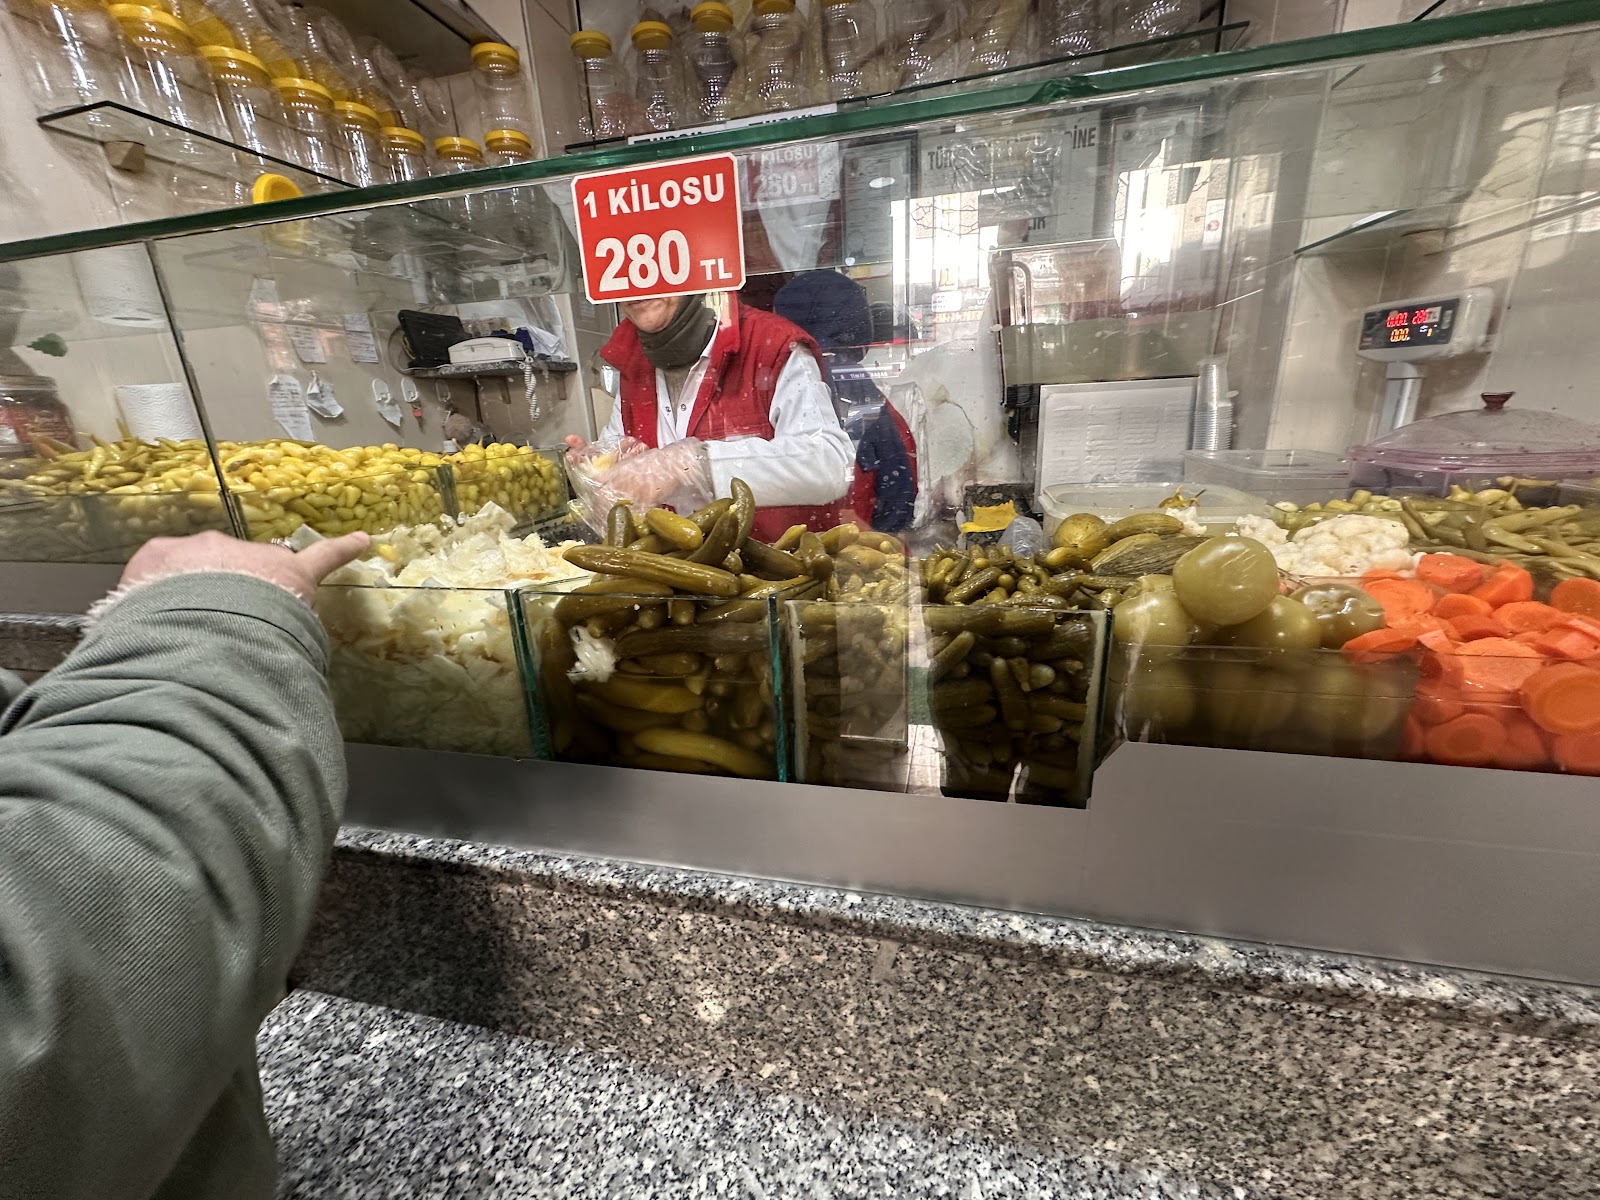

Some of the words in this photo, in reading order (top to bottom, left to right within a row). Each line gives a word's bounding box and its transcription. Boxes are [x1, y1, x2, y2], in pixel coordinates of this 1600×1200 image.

[583, 191, 598, 218] 1
[607, 172, 724, 216] KİLOSU
[753, 170, 798, 199] 280
[800, 182, 815, 193] TL
[595, 229, 691, 293] 280
[699, 257, 733, 281] TL
